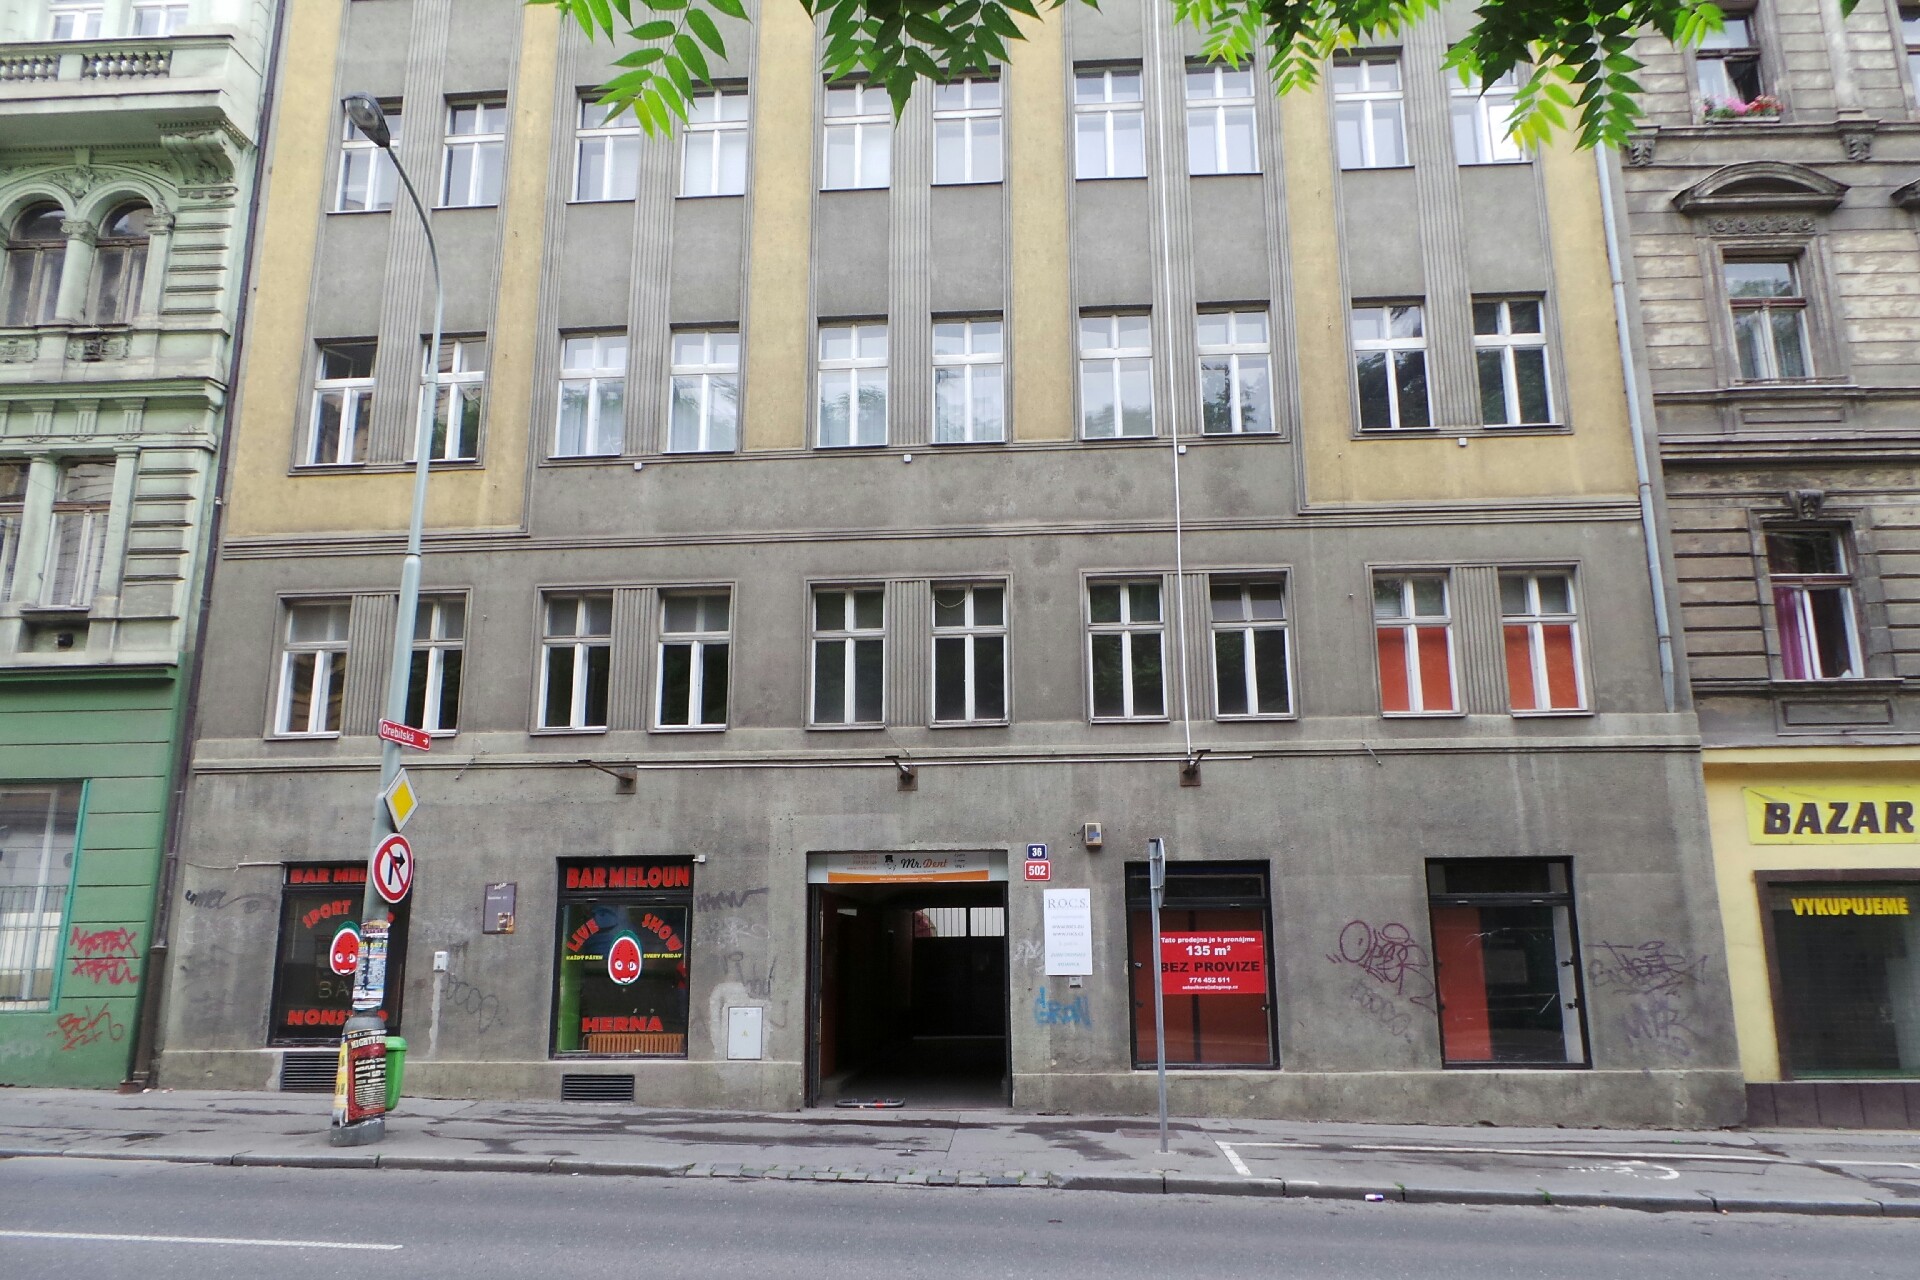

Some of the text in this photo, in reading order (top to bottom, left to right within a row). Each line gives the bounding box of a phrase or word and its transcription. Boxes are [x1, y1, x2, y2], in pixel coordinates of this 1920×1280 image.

[383, 723, 415, 742] Orebitská
[1763, 801, 1915, 835] BAZAR
[1031, 847, 1043, 857] 36
[900, 858, 948, 869] Mr. Dent
[1028, 865, 1046, 876] 502
[290, 867, 330, 884] BAR
[566, 866, 690, 889] BAR MELOUN
[303, 900, 352, 929] SPORT
[1791, 897, 1909, 916] VYKUPUJEME
[566, 918, 600, 952] LIVE
[641, 913, 684, 951] SHOW
[1178, 936, 1207, 944] prodejna
[1223, 936, 1255, 944] pronájmu
[1186, 945, 1211, 956] 135
[1161, 961, 1260, 973] BEZ PROVIZE
[582, 1016, 664, 1032] HERNA
